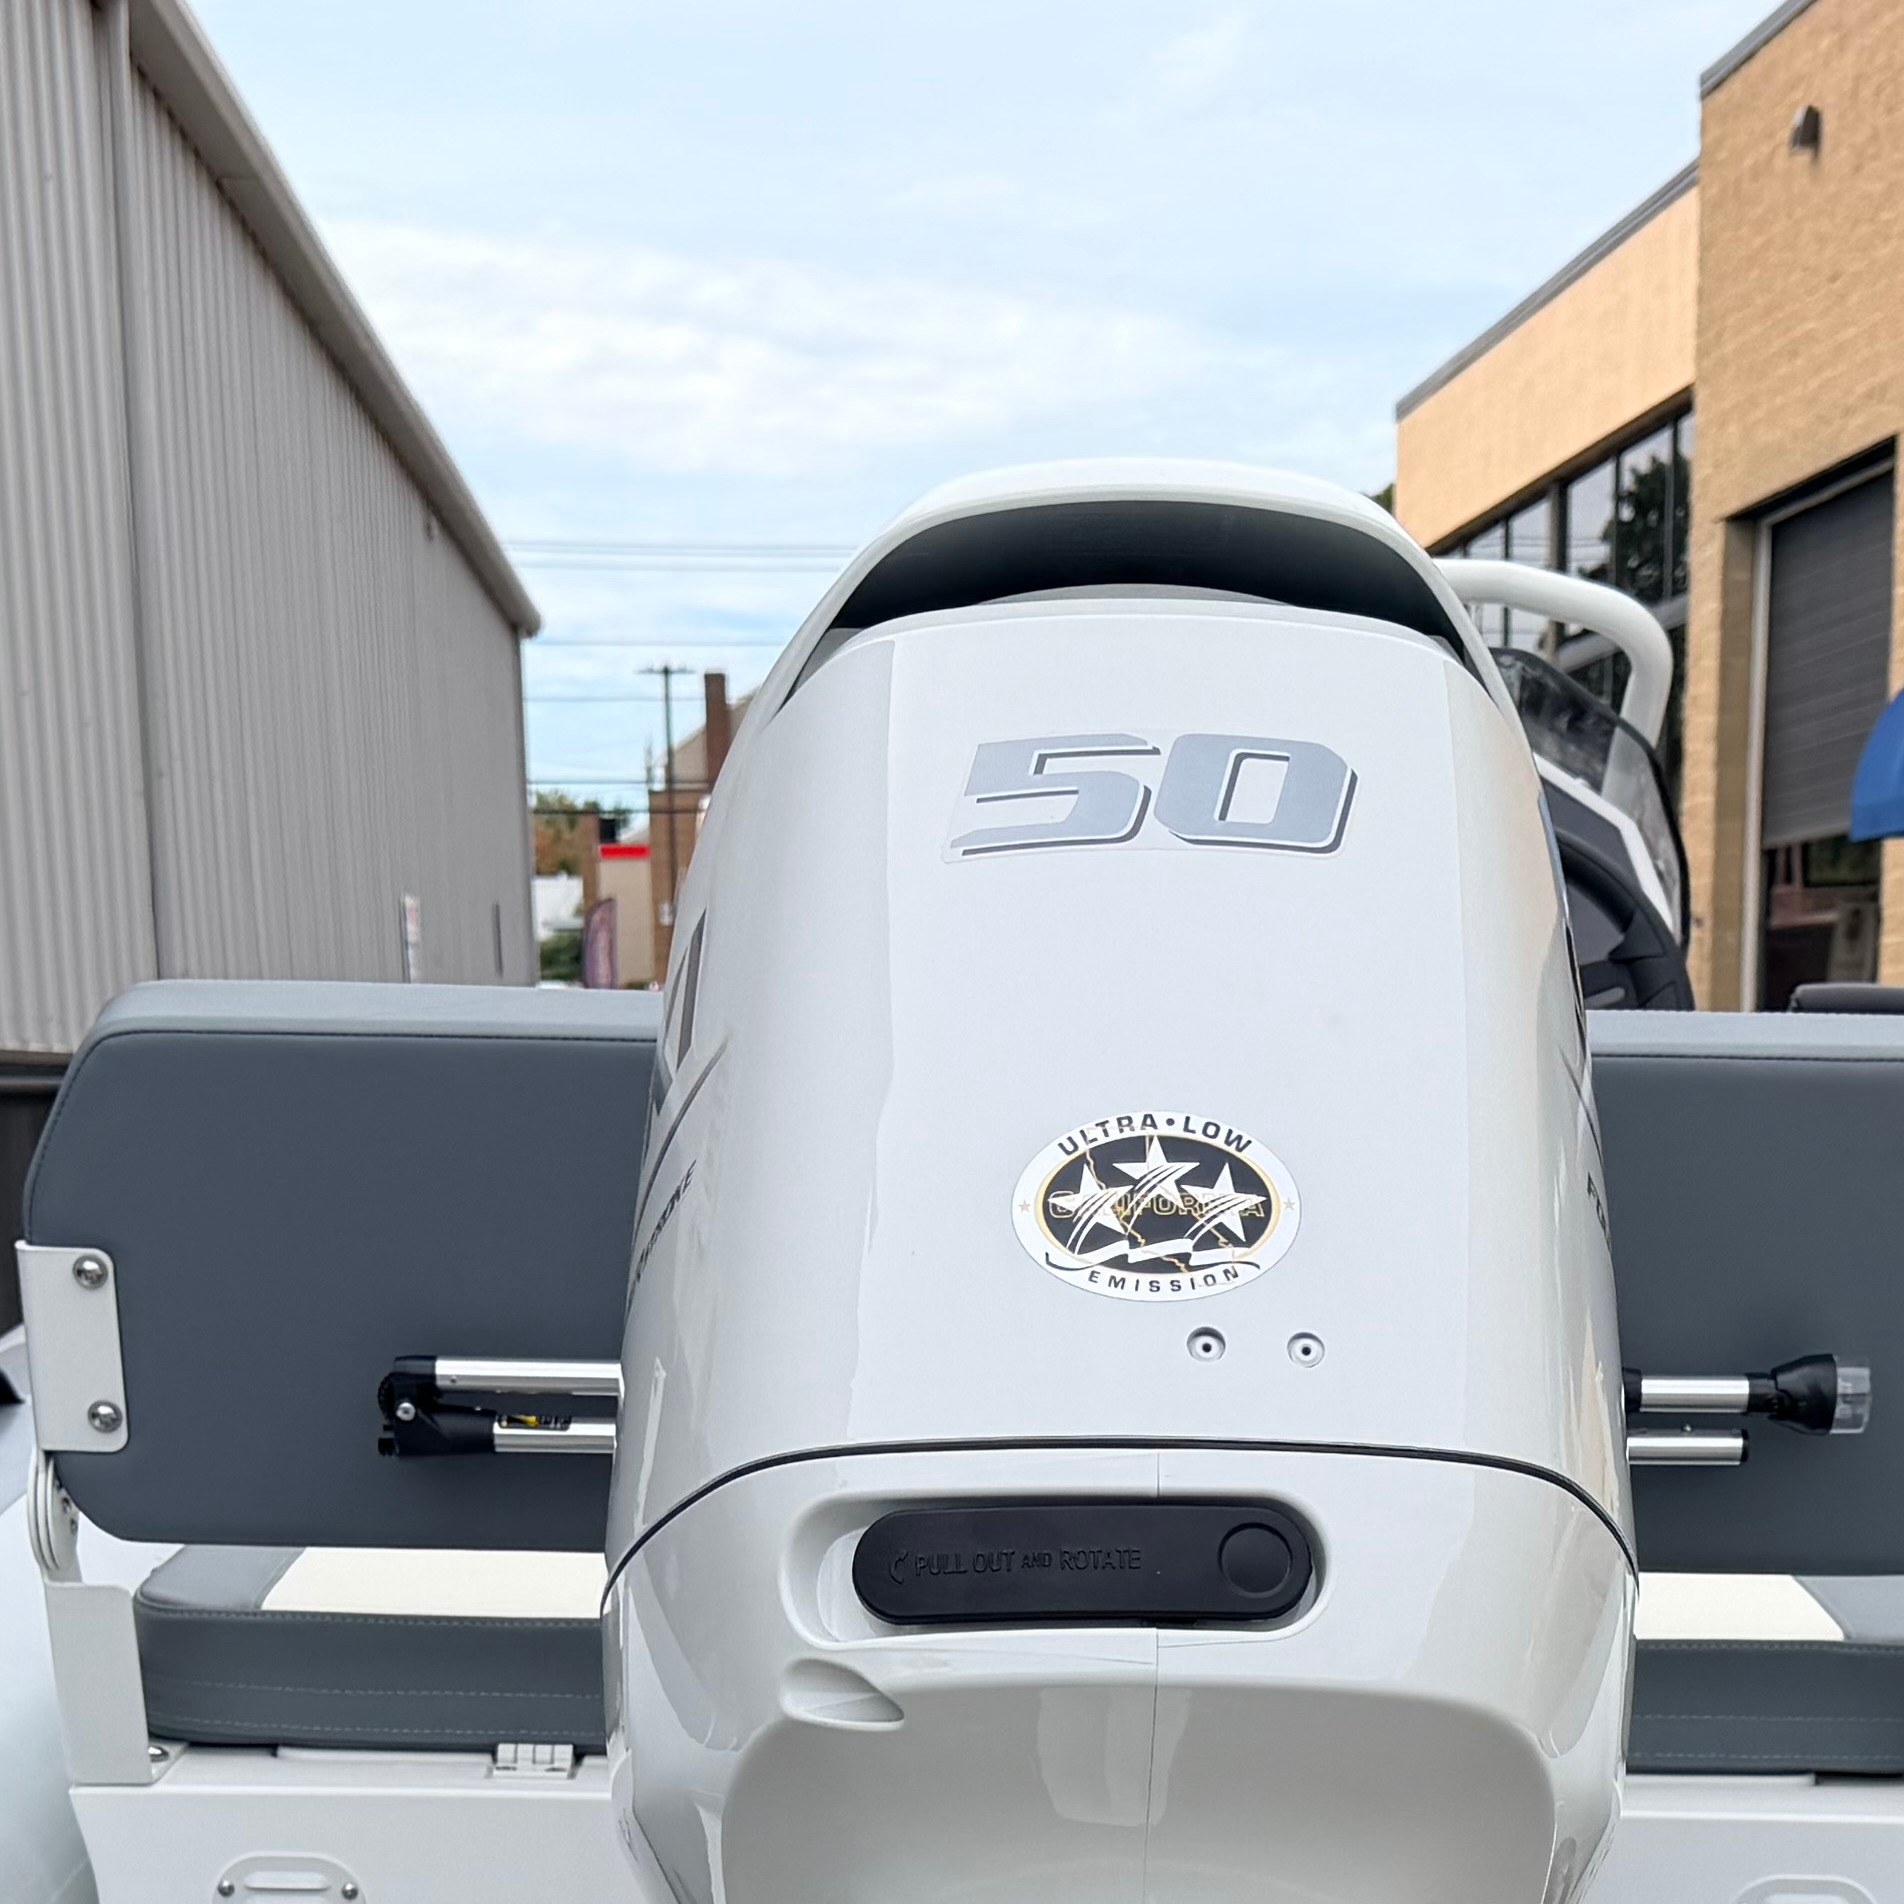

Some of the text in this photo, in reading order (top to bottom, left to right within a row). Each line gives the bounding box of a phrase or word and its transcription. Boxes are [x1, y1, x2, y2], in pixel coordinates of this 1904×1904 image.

[950, 733, 1358, 856] 50
[1057, 1113, 1253, 1156] ULTRA LOW
[1089, 1266, 1238, 1293] EMISSION
[914, 1549, 1142, 1576] PULL OUT AND ROTATE
